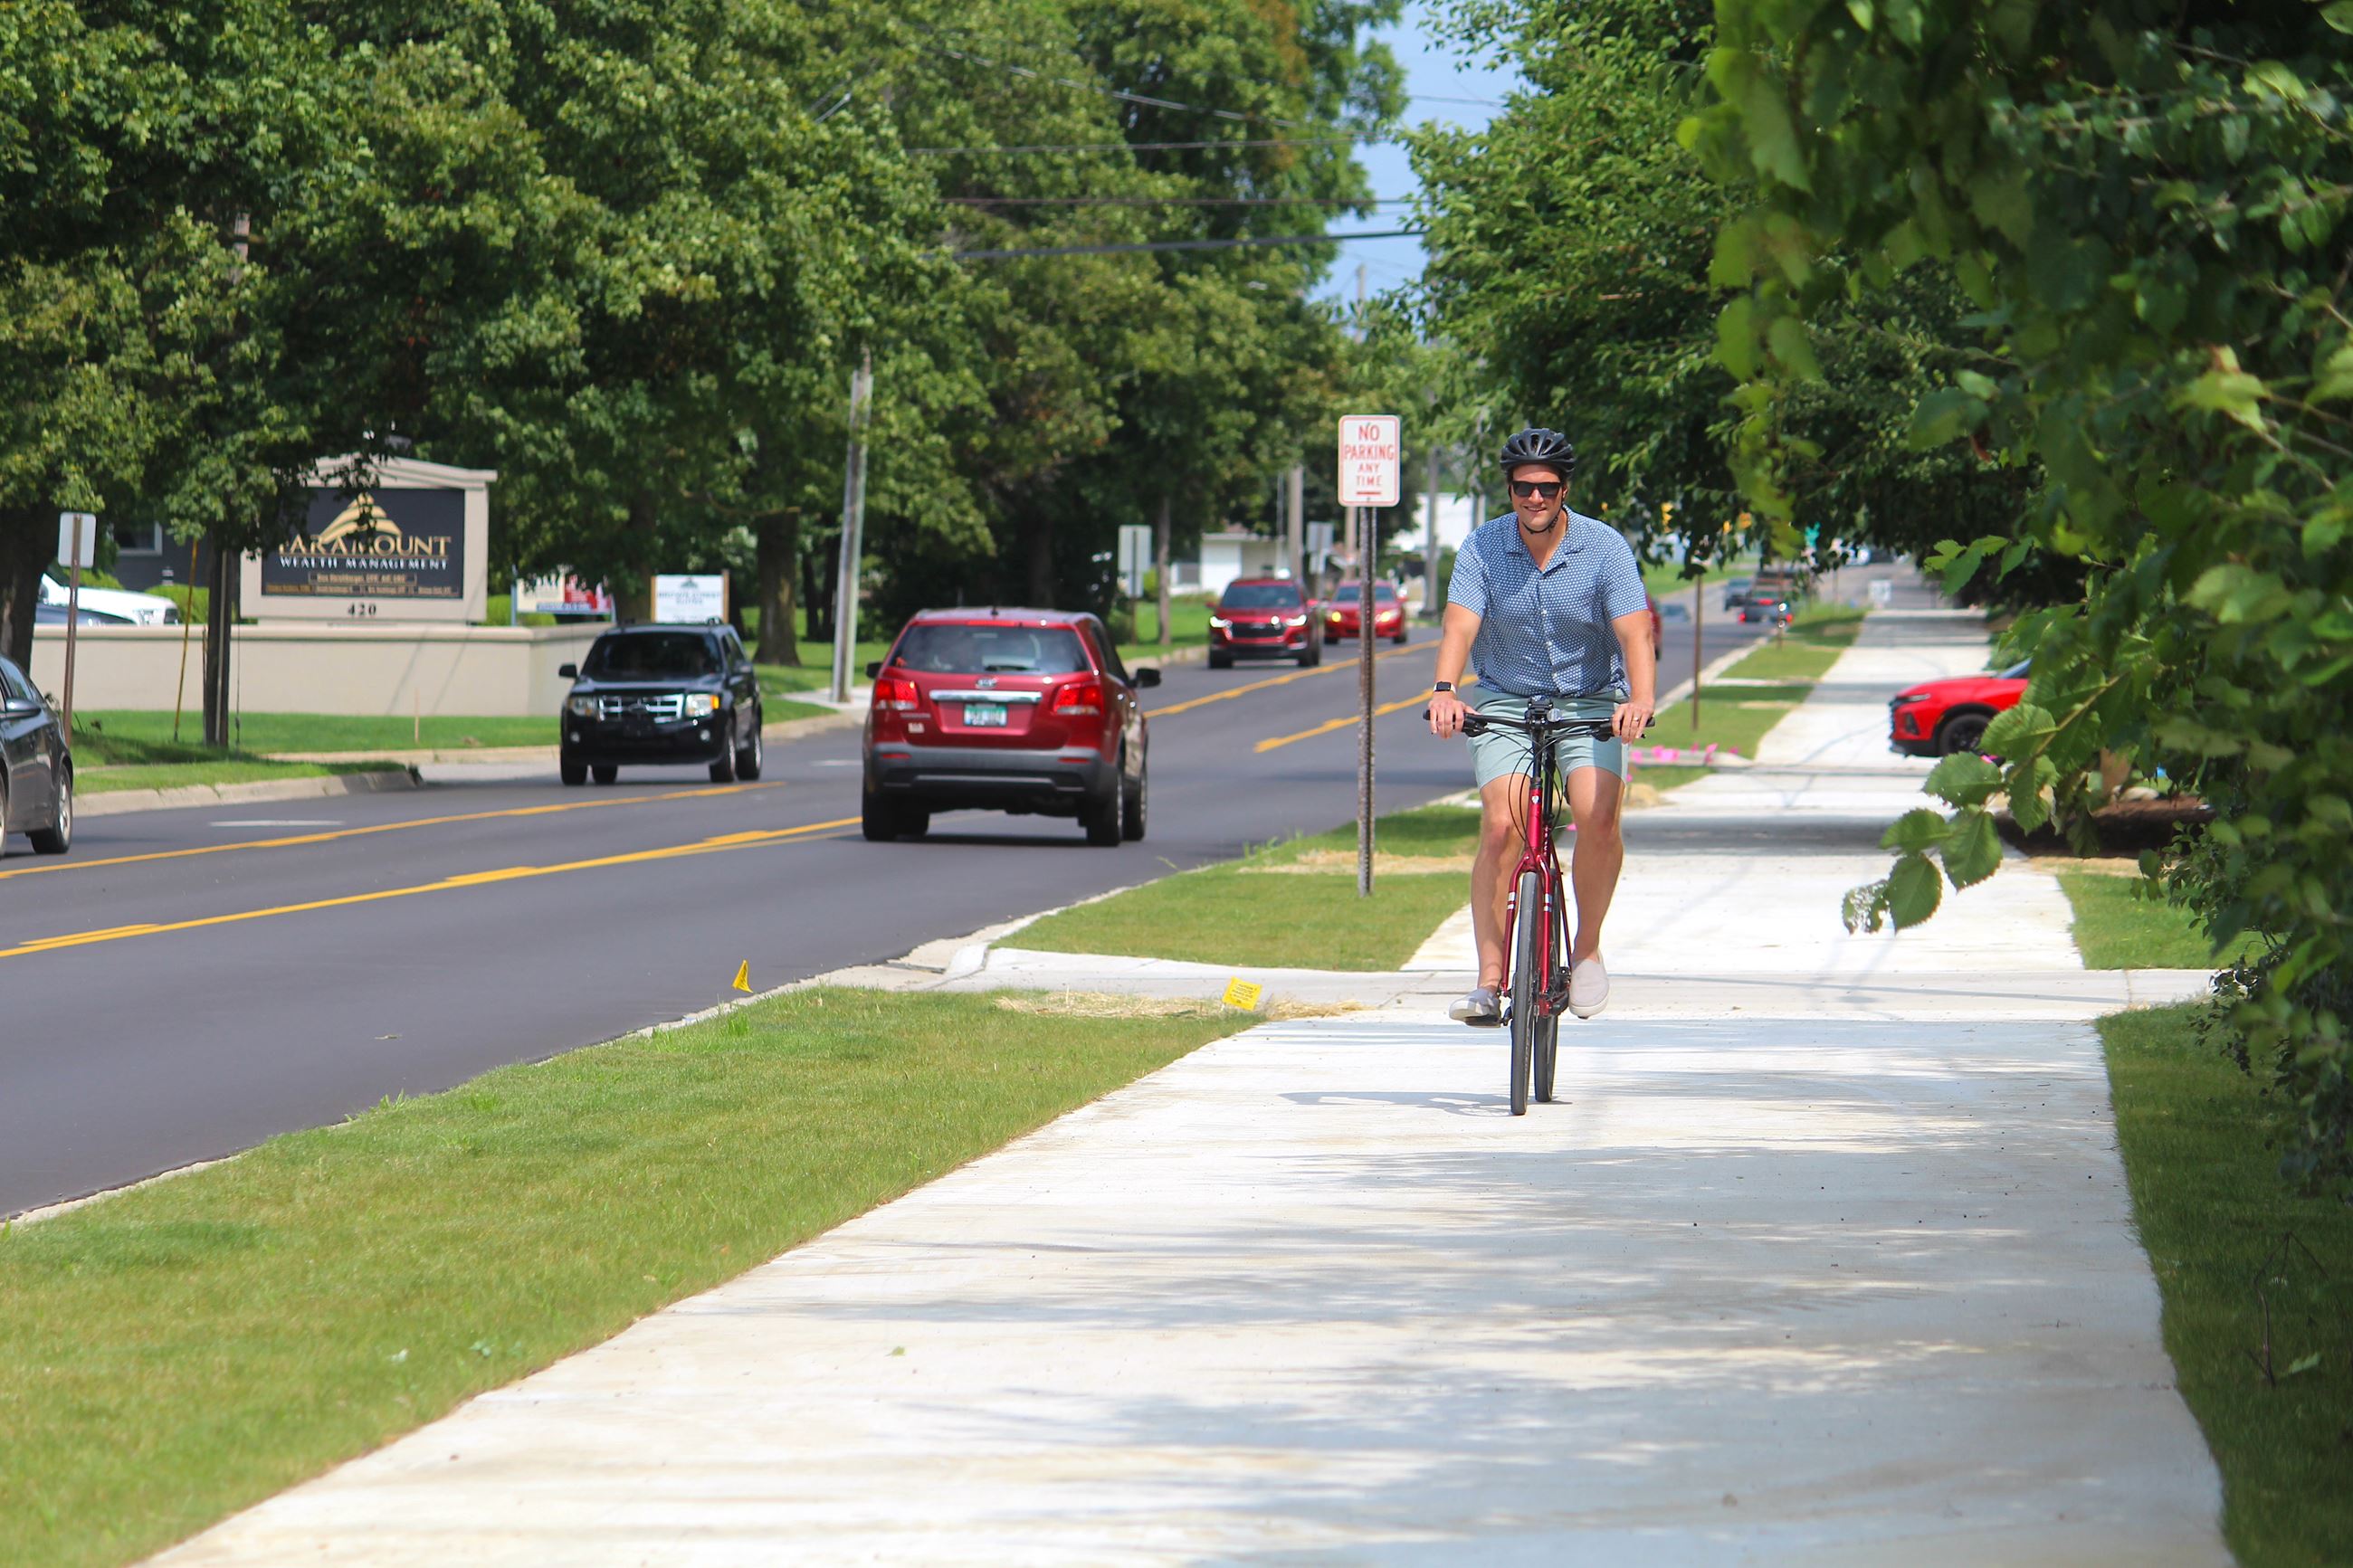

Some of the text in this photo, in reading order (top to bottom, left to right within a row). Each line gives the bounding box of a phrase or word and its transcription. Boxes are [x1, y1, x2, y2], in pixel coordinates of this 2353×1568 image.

[1358, 424, 1380, 441] NO
[1345, 444, 1394, 461] PARKING
[1358, 463, 1380, 472] ANY
[1357, 476, 1382, 486] TIME
[280, 556, 448, 570] WEALTH MANAGEMENT
[348, 603, 376, 615] 420
